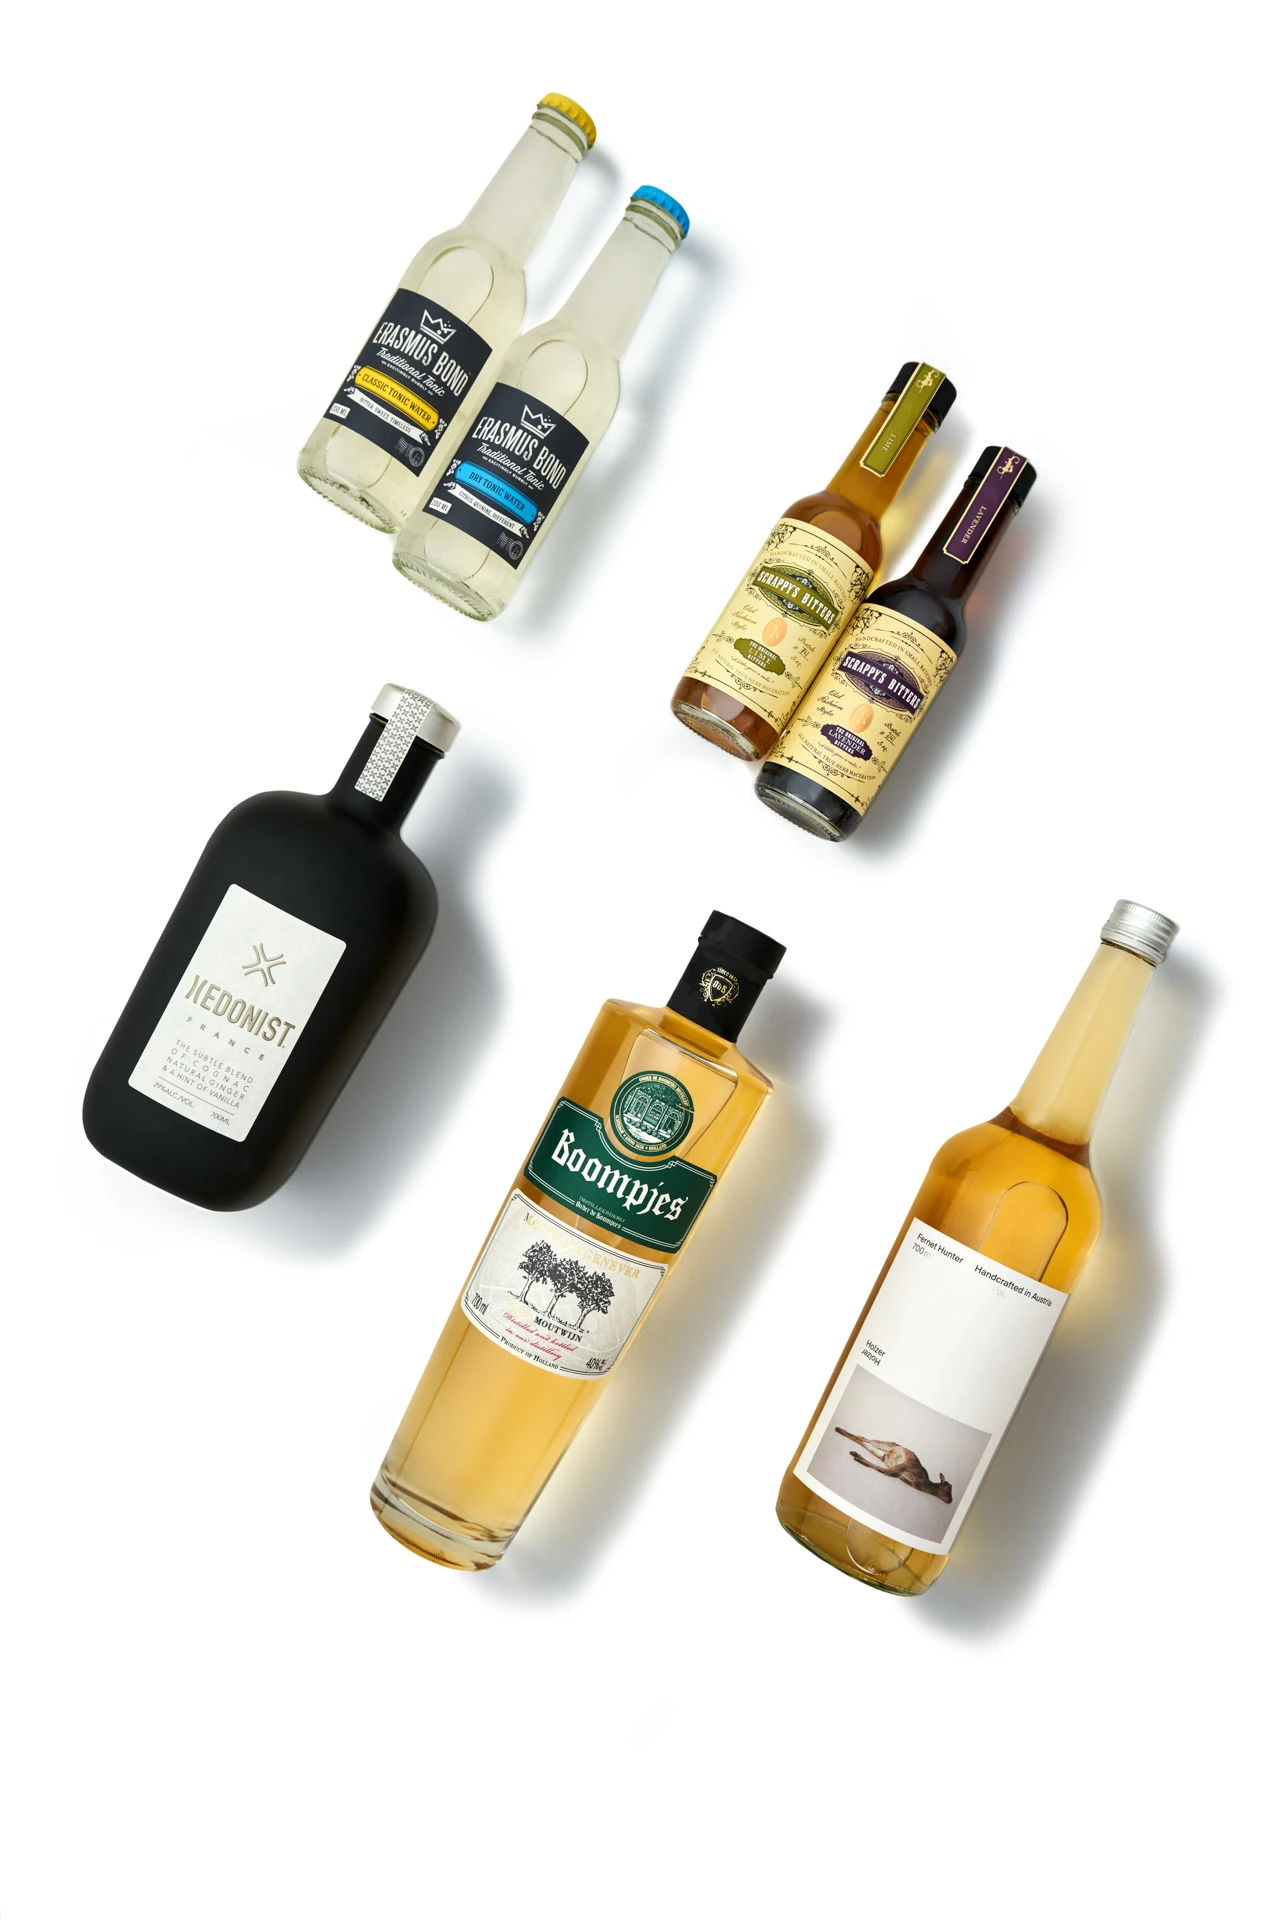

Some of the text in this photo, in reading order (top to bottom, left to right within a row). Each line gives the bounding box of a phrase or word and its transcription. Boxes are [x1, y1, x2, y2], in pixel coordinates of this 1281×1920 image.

[372, 322, 469, 396] ERASMUS BOND
[376, 347, 445, 397] Traditional Tonic
[387, 364, 427, 390] EXCITINGLY BUBBLY
[362, 374, 431, 422] CLASSIC TONIC WATER
[472, 417, 567, 489] ERASMUS BOND
[882, 434, 896, 452] LIME
[477, 443, 544, 491] Traditional Tonic
[488, 459, 528, 485] EXCITINGLY BUBBLY
[469, 472, 526, 512] DRY TONIC WATER
[961, 506, 987, 544] LAVENDER
[810, 559, 818, 567] IN
[757, 571, 835, 624] SCRAPPY'S BITTERS
[747, 654, 766, 667] BITTERS
[749, 640, 758, 649] THE
[749, 648, 771, 664] LIME
[856, 636, 897, 647] HANDCRAFTED
[897, 645, 905, 653] IN
[905, 651, 920, 666] SMALL
[843, 657, 921, 709] SCRAPPY'S BITTERS
[828, 730, 866, 755] LAVENDER
[834, 740, 854, 754] BITTERS
[835, 726, 864, 746] THE ORIGINAL
[803, 740, 821, 757] NATURAL
[823, 756, 835, 765] TRUE
[836, 764, 849, 773] HERB
[848, 770, 876, 779] MACERATION
[186, 1017, 264, 1060] FRANCE
[166, 1057, 245, 1100] NATURAL GINGER
[171, 1049, 249, 1092] OF COGNAC
[176, 1040, 254, 1083] THE SUBTLE BLEND
[161, 1064, 240, 1108] & A HINT OF VANILLA
[552, 1128, 688, 1221] Boompjes
[584, 1249, 640, 1278] GENEVER
[912, 1243, 925, 1255] 700
[917, 1234, 963, 1263] Fernet Hunter
[472, 1293, 489, 1314] 700 ml
[974, 1265, 1052, 1307] Handcrafted in Austria
[503, 1312, 578, 1352] Distilled and bottled
[505, 1327, 561, 1361] in our distillery
[534, 1316, 582, 1342] MOUTWIJN
[866, 1340, 885, 1356] Holzer
